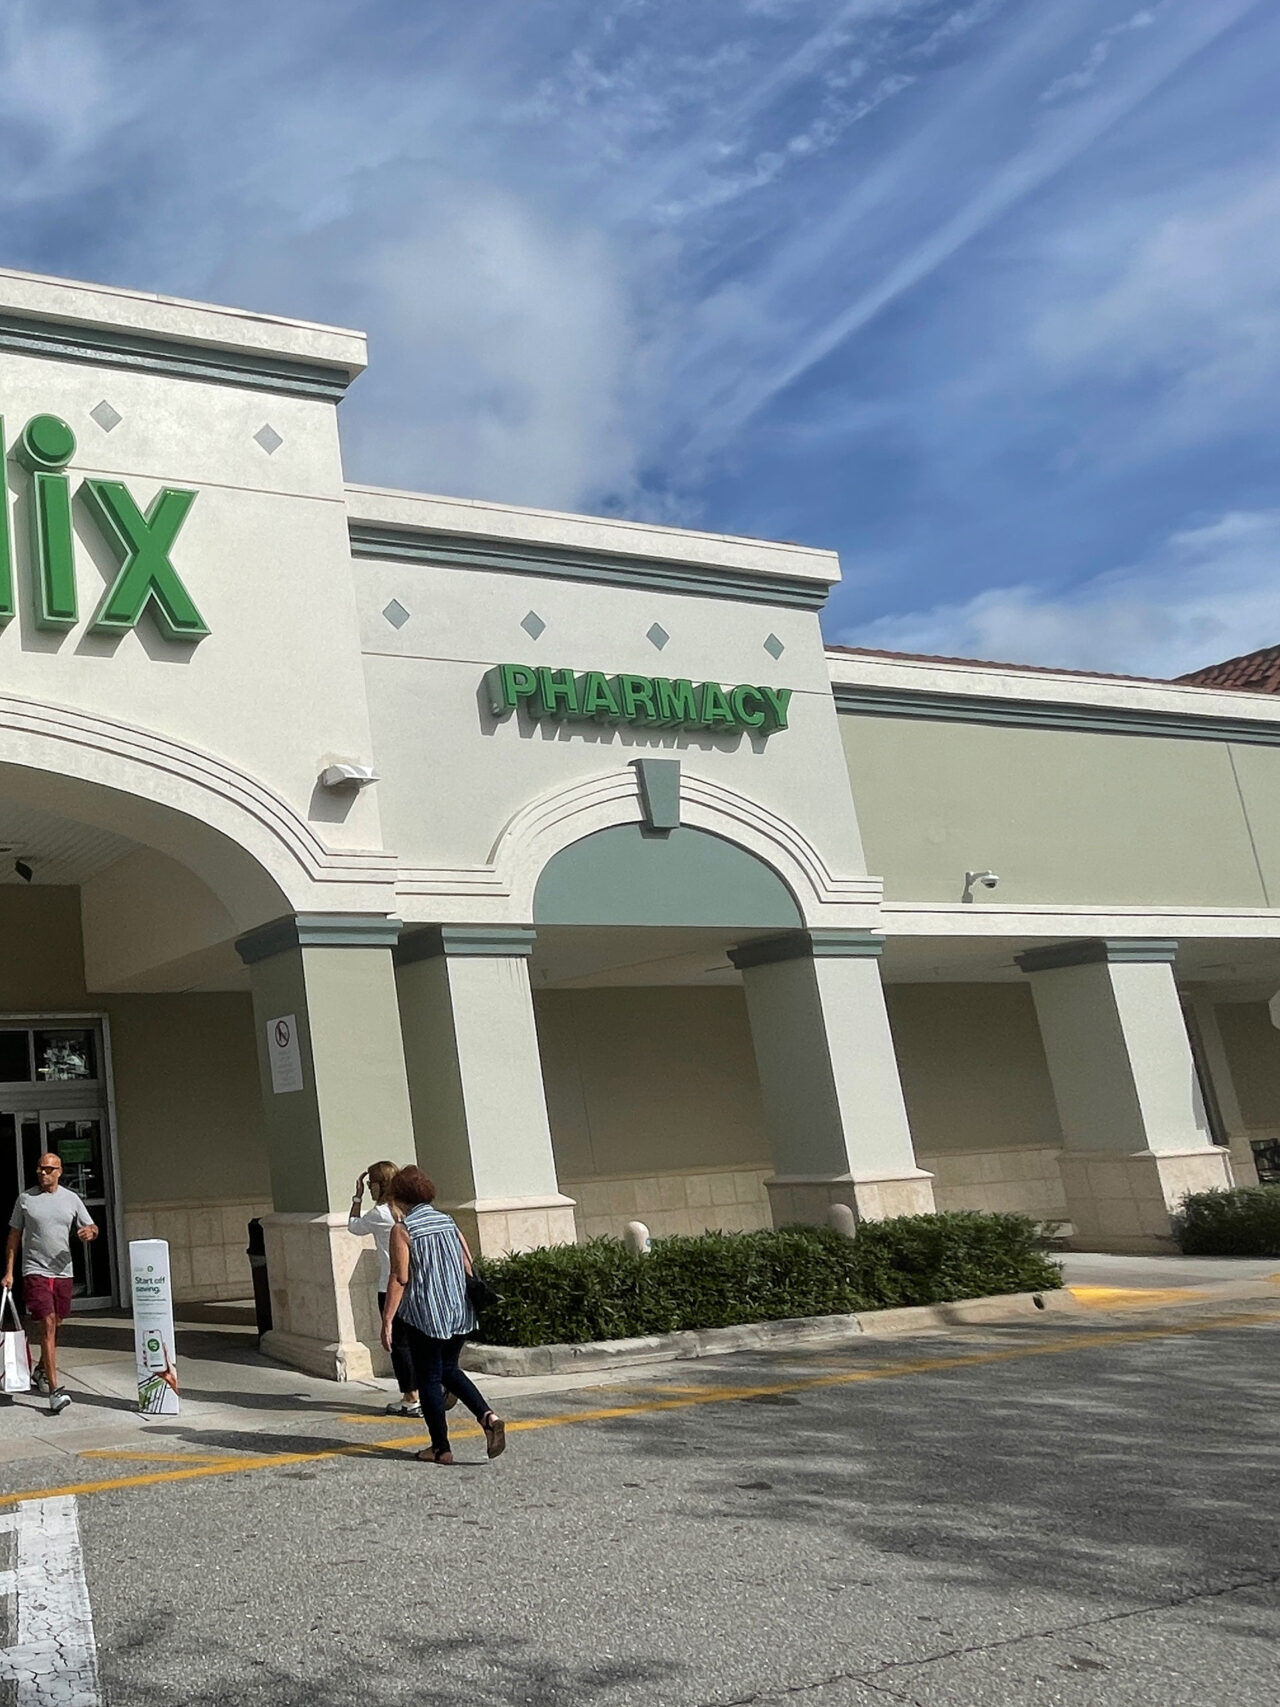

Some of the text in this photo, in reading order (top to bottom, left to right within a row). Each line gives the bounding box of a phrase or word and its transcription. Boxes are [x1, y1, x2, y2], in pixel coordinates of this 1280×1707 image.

[494, 663, 793, 732] PHARMACY
[135, 1275, 166, 1285] Start off
